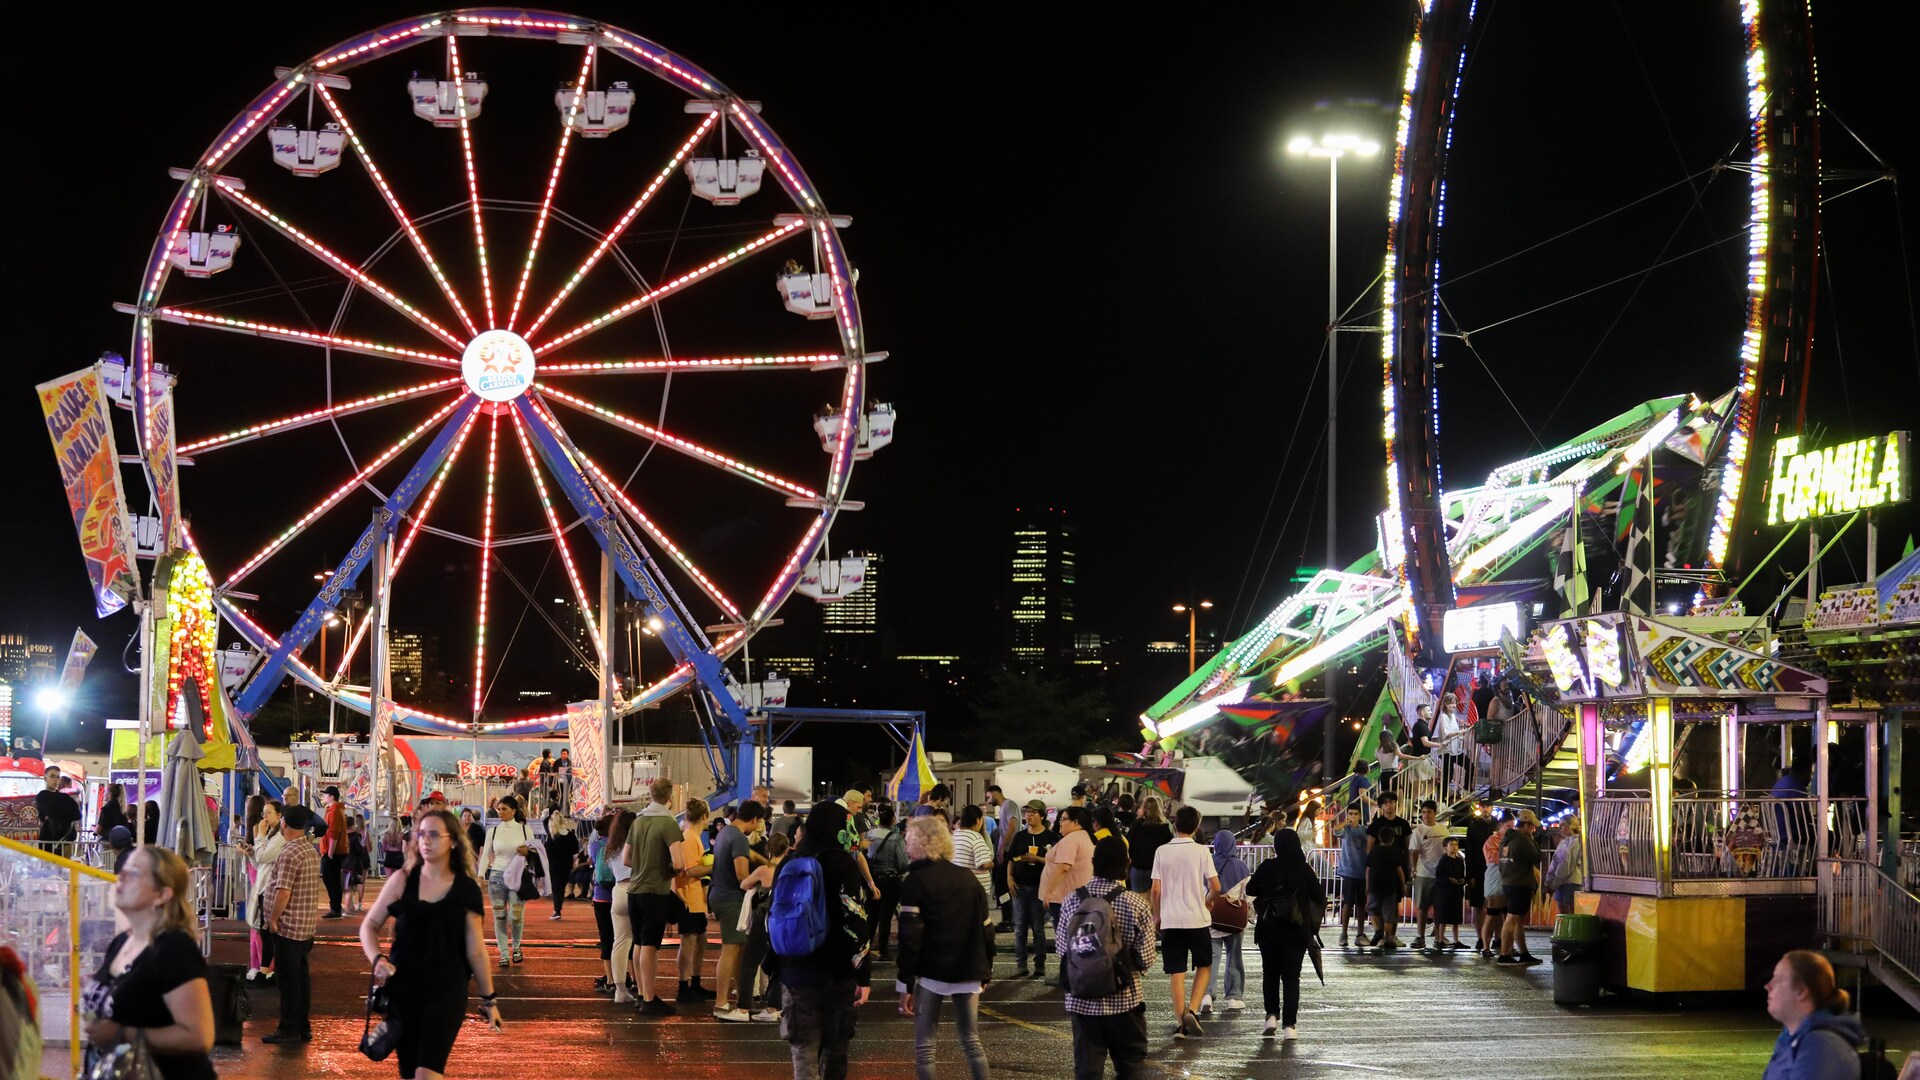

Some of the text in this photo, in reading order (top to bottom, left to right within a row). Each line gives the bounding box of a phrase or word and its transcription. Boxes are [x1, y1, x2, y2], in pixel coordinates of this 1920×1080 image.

[465, 72, 477, 80] 11
[613, 81, 629, 89] 12
[325, 122, 340, 131] 10
[46, 380, 91, 444] BEAUCE
[60, 400, 106, 487] ARNAVA
[1767, 431, 1899, 526] FORMULA
[318, 506, 393, 603] Beauce Carnal
[596, 513, 669, 614] Bece Carnaval
[232, 641, 241, 650] 6
[349, 735, 358, 743] 5
[116, 776, 158, 785] ORBIER
